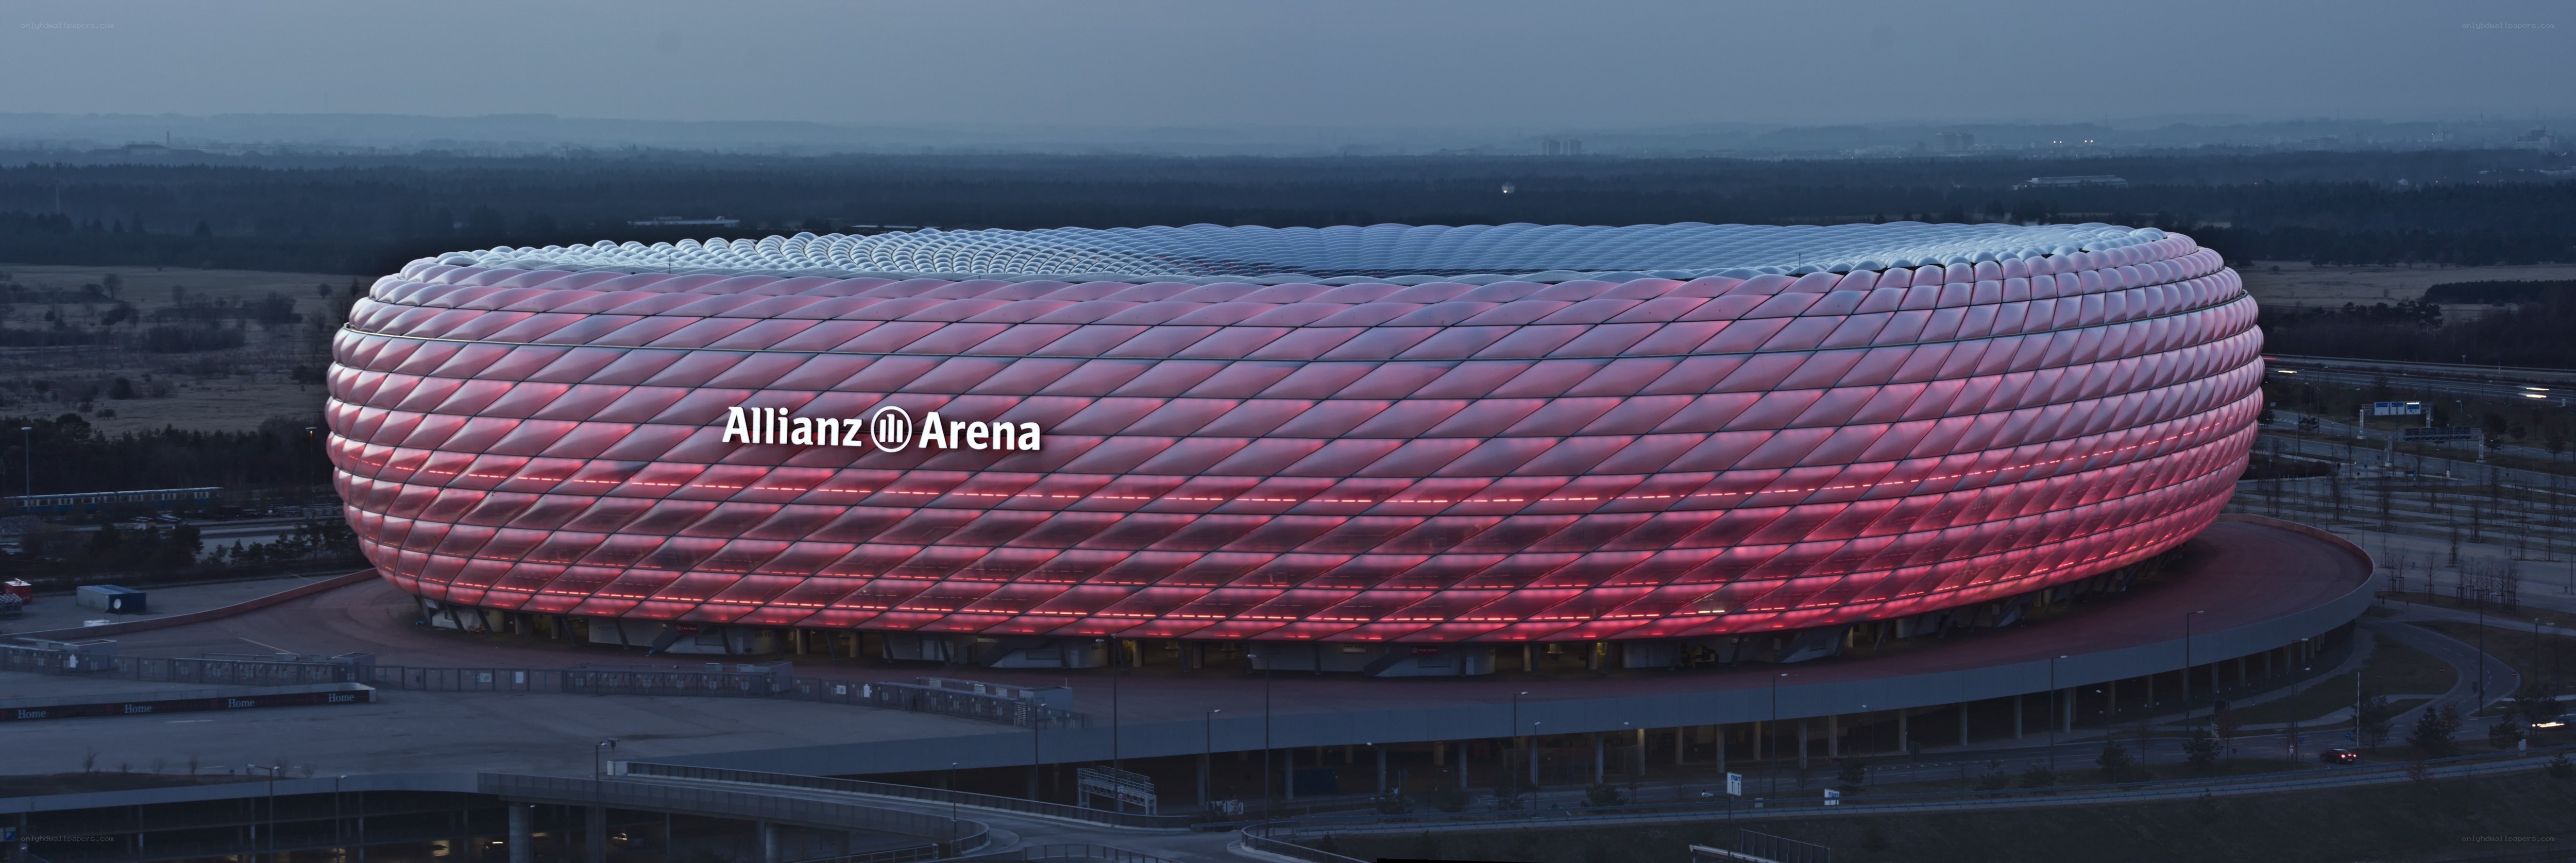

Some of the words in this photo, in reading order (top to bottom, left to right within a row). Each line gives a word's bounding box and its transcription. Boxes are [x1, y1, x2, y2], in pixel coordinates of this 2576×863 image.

[722, 406, 863, 446] Allianz
[918, 412, 1041, 451] Arena
[328, 693, 354, 702] Home
[228, 698, 255, 708] Home
[18, 709, 47, 719] Home
[124, 704, 152, 714] Home
